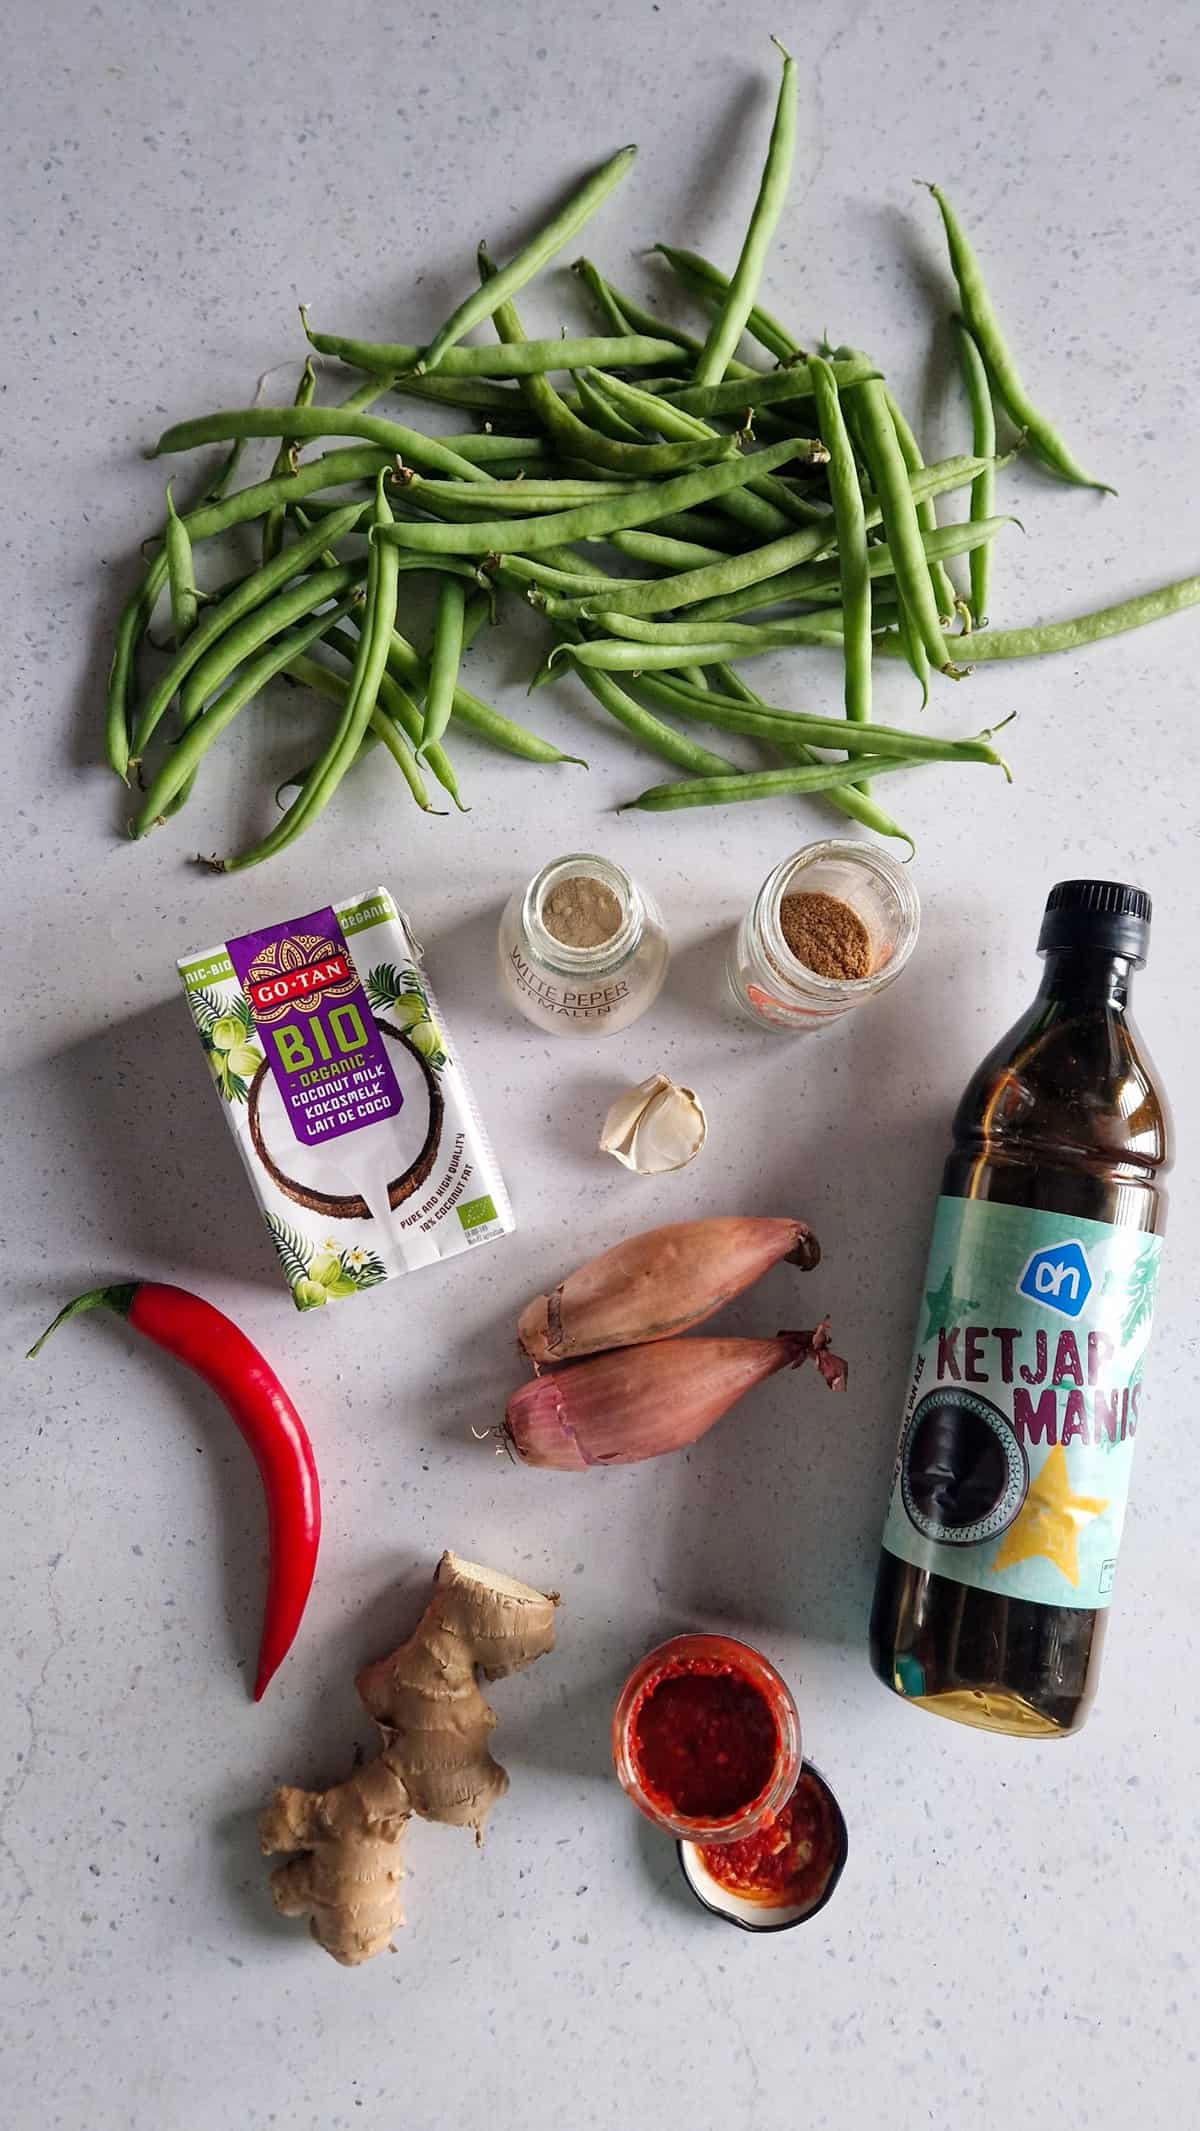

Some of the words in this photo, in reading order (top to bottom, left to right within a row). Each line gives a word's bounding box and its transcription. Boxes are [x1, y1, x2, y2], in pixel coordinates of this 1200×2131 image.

[341, 902, 392, 930] ORGANIC
[511, 944, 558, 998] WITTE
[563, 981, 629, 1007] PEPER
[272, 1003, 368, 1073] BIO
[291, 1077, 349, 1107] COCONUT
[353, 1064, 386, 1085] MILK
[299, 1054, 365, 1088] ORGANIC
[305, 1082, 383, 1119] KOKOSMELK
[306, 1116, 336, 1136] LAIT
[338, 1109, 356, 1124] DE
[357, 1096, 392, 1117] COCO
[400, 1211, 422, 1230] PURE
[422, 1196, 438, 1214] AND
[436, 1175, 453, 1198] HIGH
[448, 1132, 465, 1174] QUALITY
[435, 1181, 465, 1221] COCONUT
[461, 1164, 475, 1182] FAT
[936, 1327, 1114, 1386] KETJAP
[907, 1385, 919, 1411] VAN
[1013, 1384, 1142, 1446] MANIS
